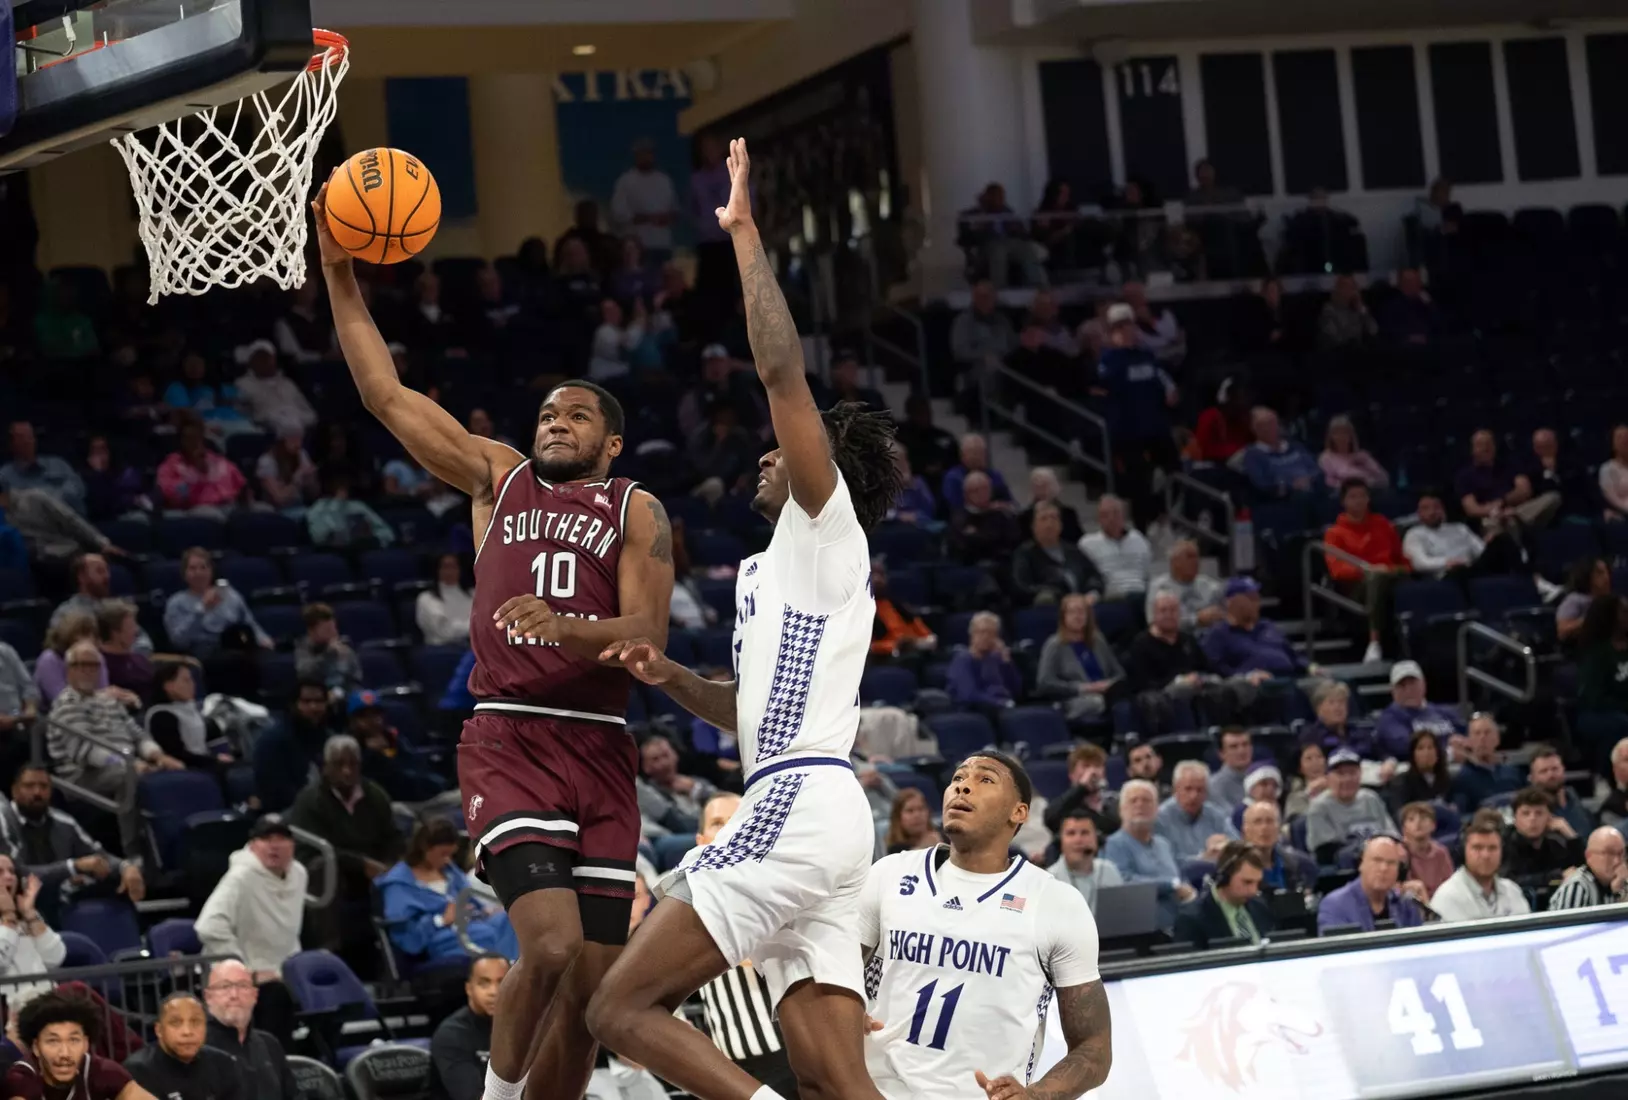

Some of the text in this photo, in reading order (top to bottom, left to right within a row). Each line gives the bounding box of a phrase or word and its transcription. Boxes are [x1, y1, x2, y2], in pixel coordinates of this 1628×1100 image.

[1122, 64, 1180, 98] 114
[503, 508, 618, 559] SOUTHERN
[531, 551, 577, 598] 10
[943, 903, 964, 911] adidas
[889, 930, 1011, 977] HIGH POINT
[906, 978, 965, 1051] 11
[1388, 973, 1485, 1056] 41
